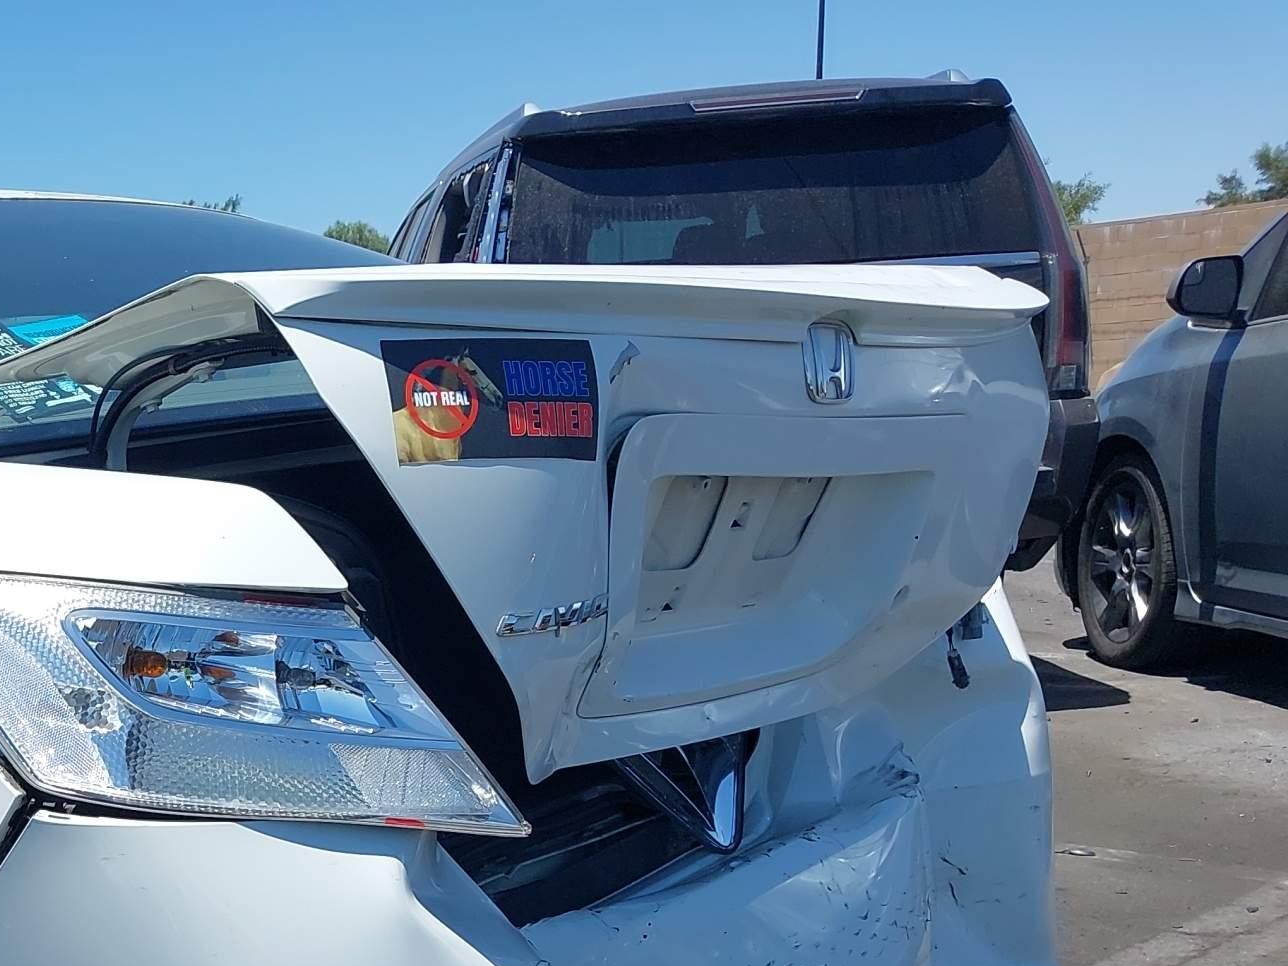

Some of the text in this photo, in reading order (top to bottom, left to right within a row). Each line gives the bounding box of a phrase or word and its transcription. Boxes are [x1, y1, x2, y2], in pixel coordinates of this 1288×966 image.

[501, 359, 591, 398] HORSE
[413, 389, 471, 408] NOT REAL
[507, 401, 594, 438] DENIER
